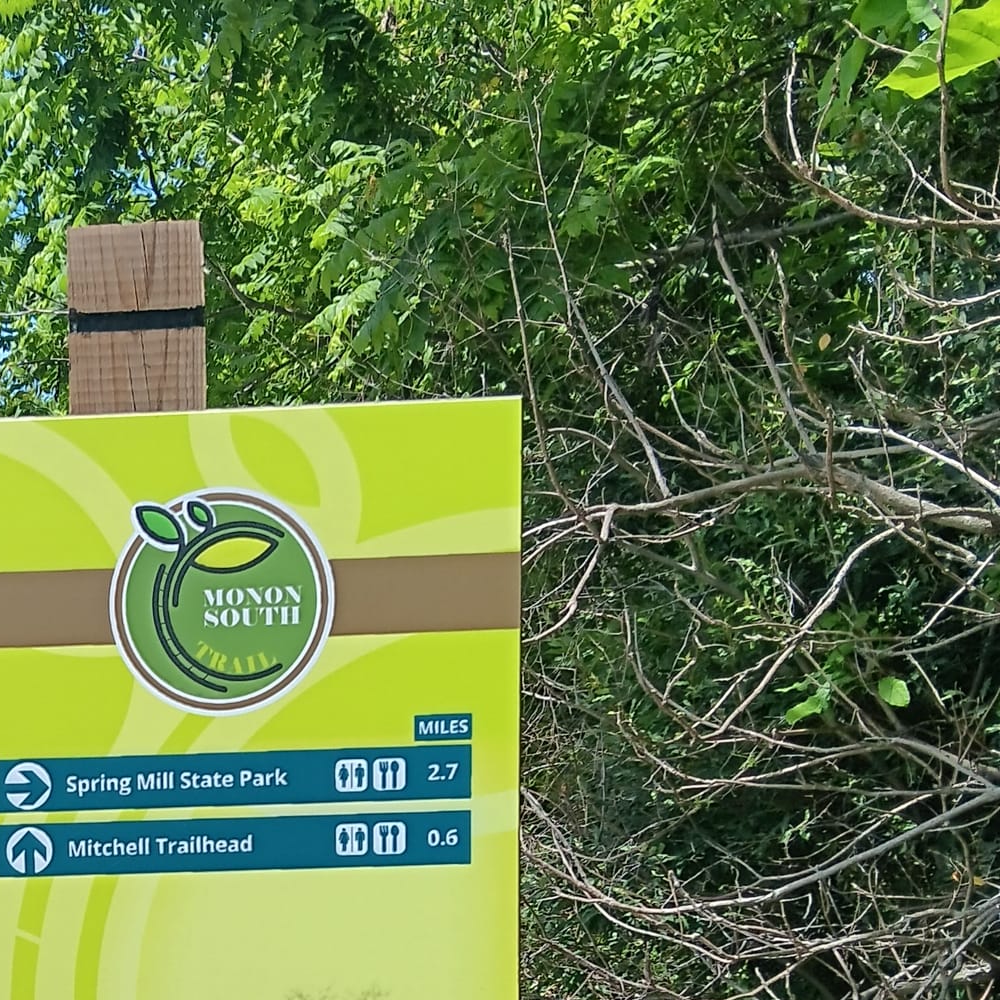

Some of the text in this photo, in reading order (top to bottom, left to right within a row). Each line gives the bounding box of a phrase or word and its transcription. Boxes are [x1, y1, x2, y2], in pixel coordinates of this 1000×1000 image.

[203, 585, 302, 607] MONON
[203, 606, 300, 628] SOUTH
[195, 640, 278, 673] TRAIL
[418, 719, 469, 735] MILES
[66, 763, 459, 797] Spring Mill State Park 2.7
[68, 829, 459, 857] Mitchell Trailhead 0.6
